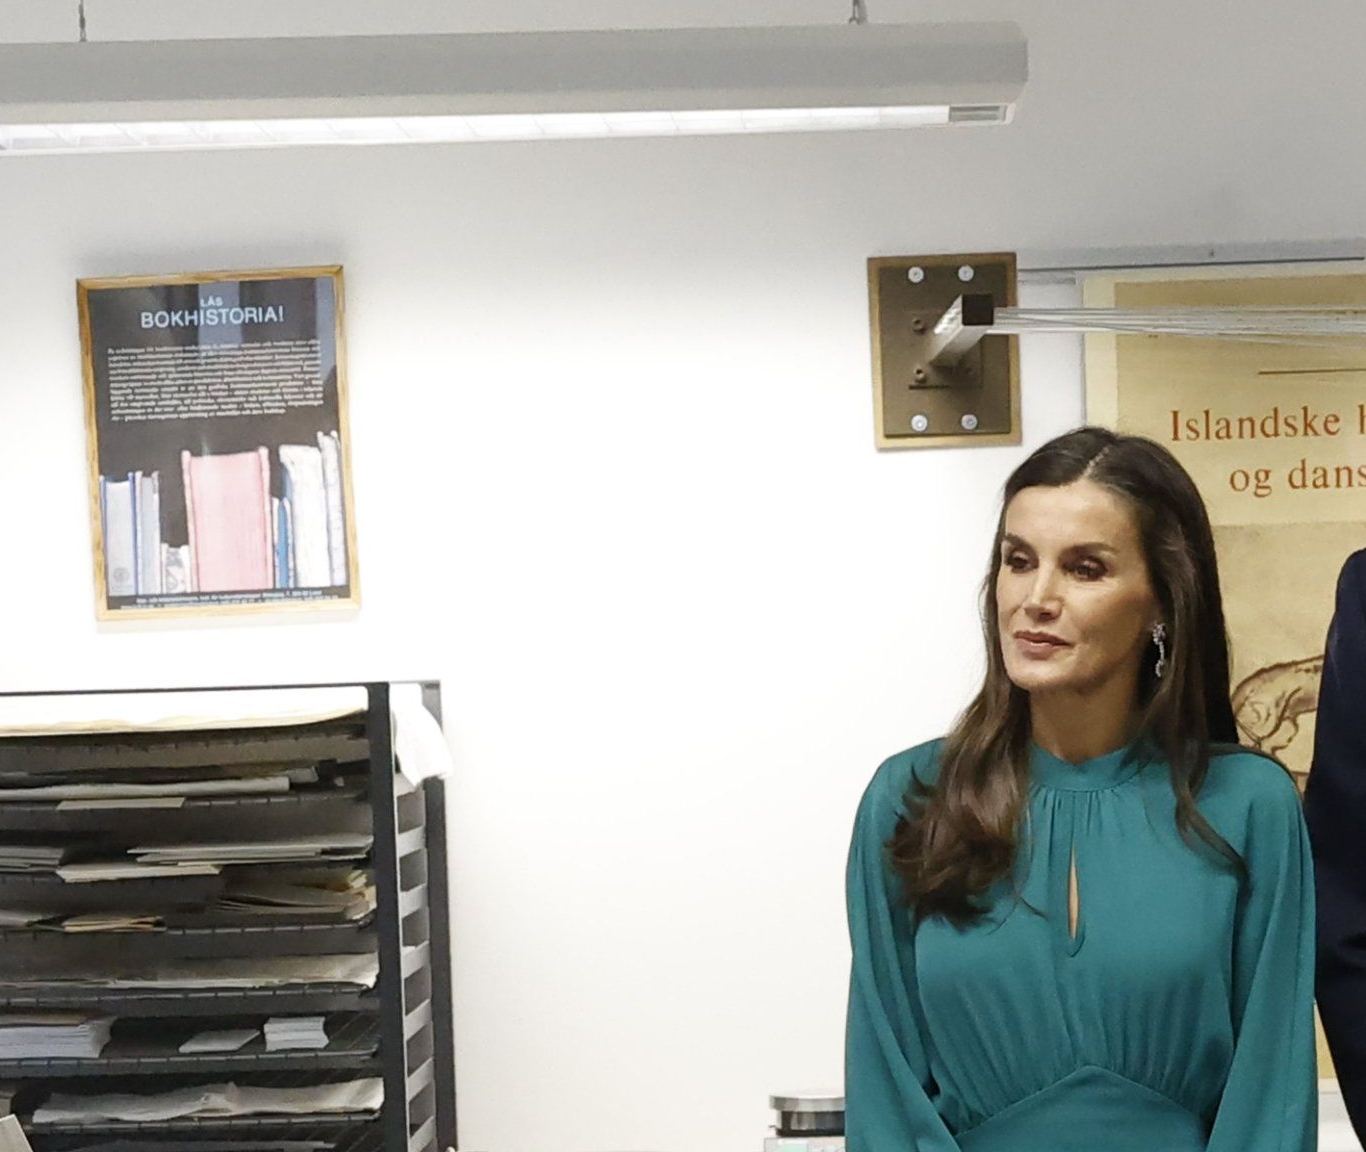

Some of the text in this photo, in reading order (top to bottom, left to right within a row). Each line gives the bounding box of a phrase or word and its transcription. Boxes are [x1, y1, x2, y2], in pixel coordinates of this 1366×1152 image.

[140, 305, 285, 329] BOKHISTORIA!
[1170, 405, 1341, 442] Islandske
[1229, 467, 1273, 498] og
